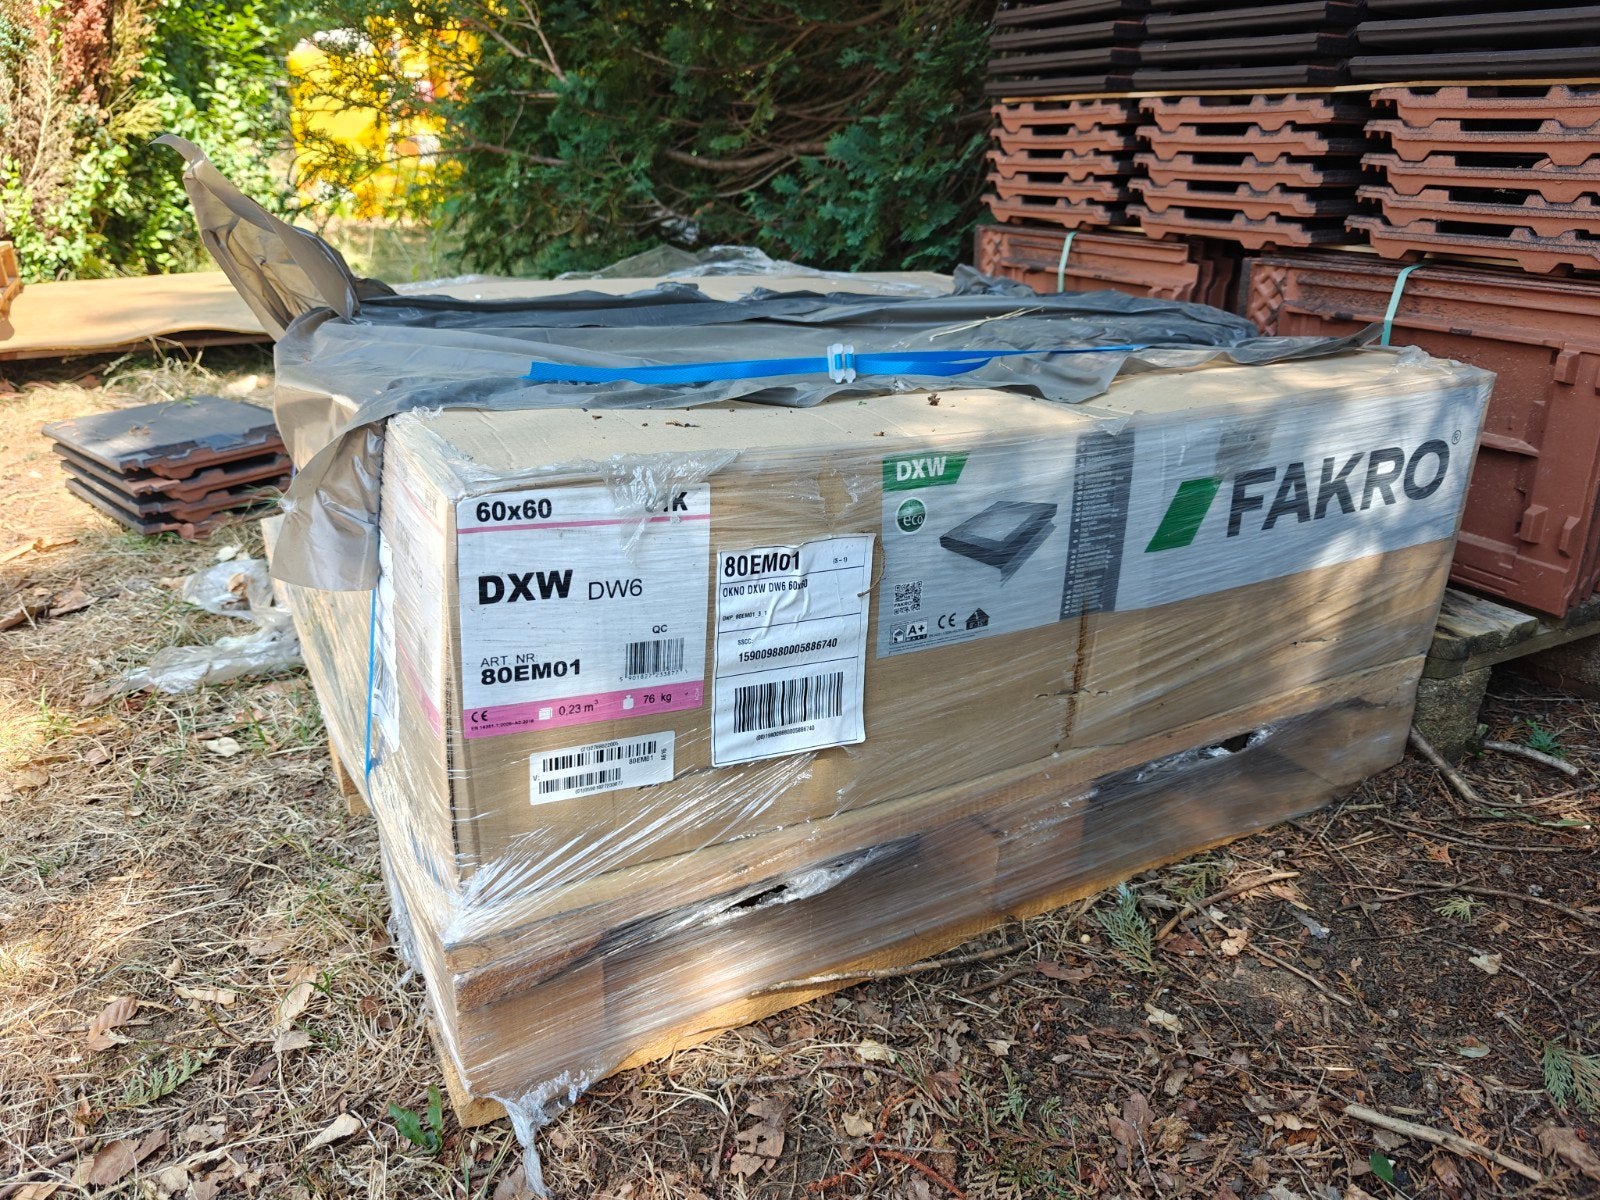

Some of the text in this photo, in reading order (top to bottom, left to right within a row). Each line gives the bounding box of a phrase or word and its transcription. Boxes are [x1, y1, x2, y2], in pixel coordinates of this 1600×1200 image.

[896, 456, 947, 481] DXW
[1226, 438, 1450, 538] FAKRO
[476, 498, 552, 522] 60x60
[903, 513, 924, 526] eco
[724, 551, 800, 578] 80EM01
[478, 569, 643, 605] DXW DW6
[722, 585, 745, 598] OKNO
[747, 583, 766, 595] DXW
[768, 581, 786, 593] DW6
[652, 624, 668, 634] QC
[907, 624, 925, 636] A+
[738, 637, 838, 663] 159009880005886740
[480, 658, 581, 686] 80EM01
[558, 703, 582, 717] 0,23
[643, 692, 672, 704] 76 kg
